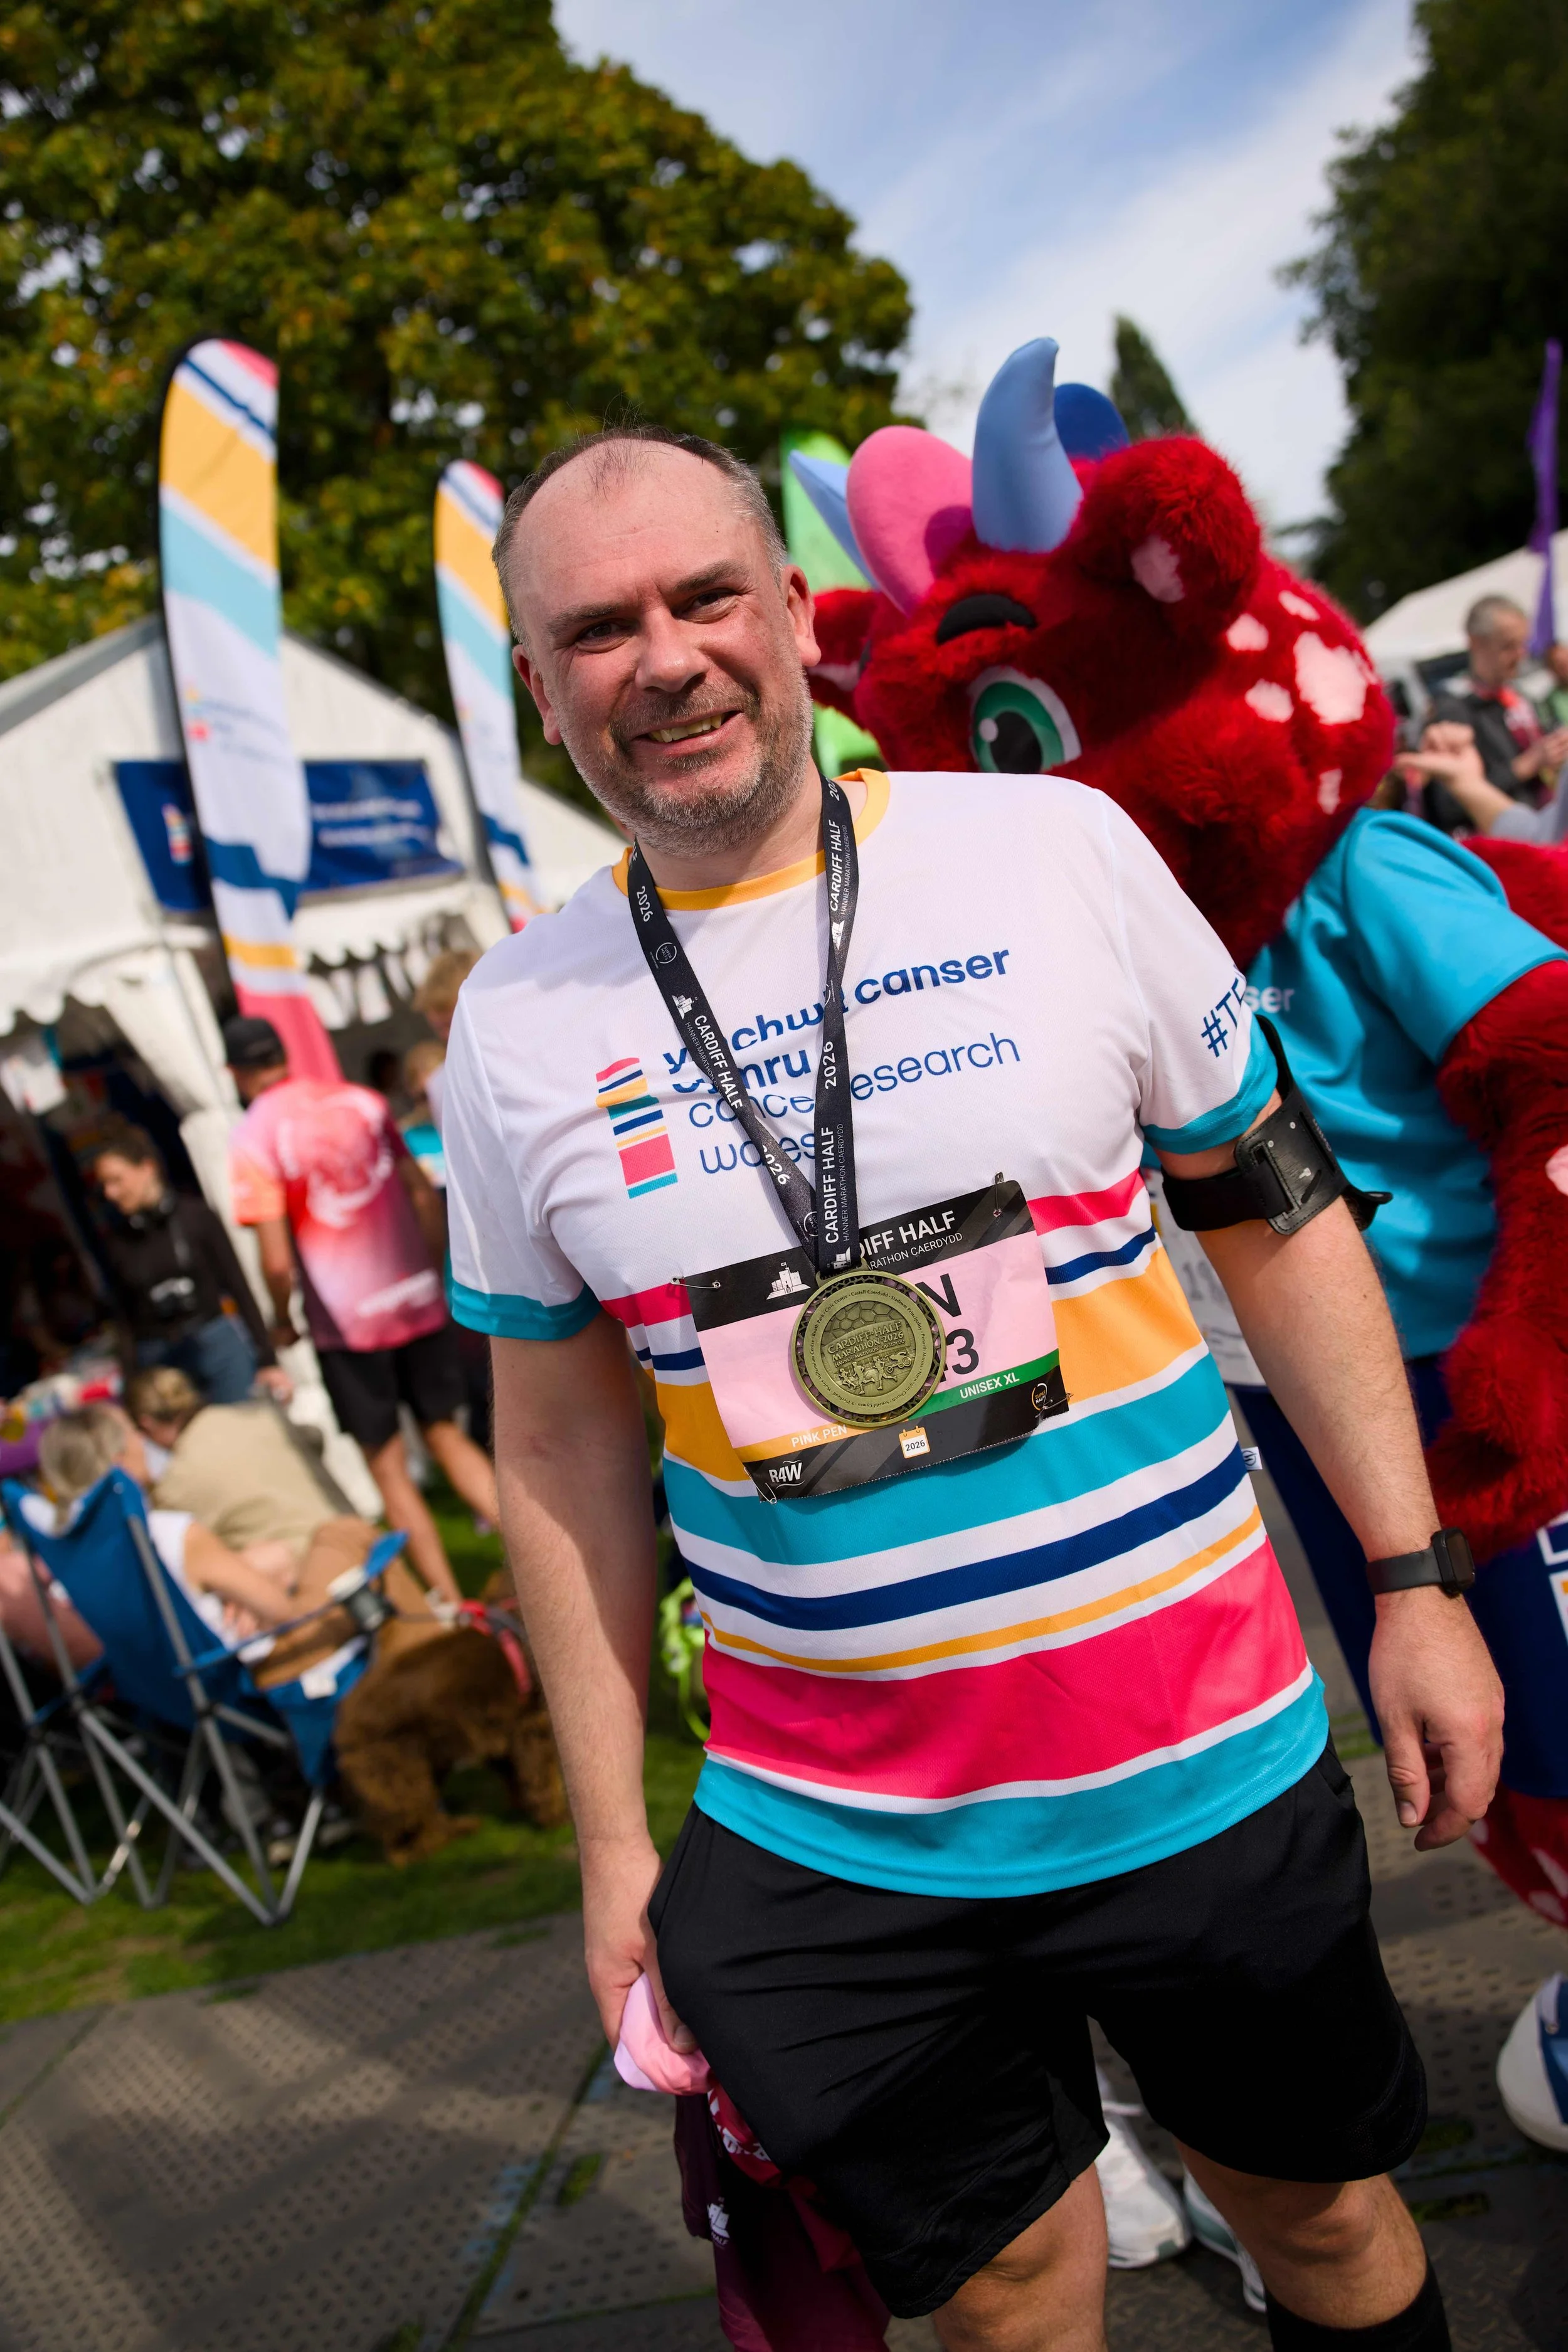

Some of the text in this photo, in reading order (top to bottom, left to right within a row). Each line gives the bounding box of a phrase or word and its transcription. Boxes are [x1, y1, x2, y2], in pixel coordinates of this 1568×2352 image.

[842, 825, 850, 852] CAERDYDD
[829, 819, 842, 911] CARDIFF HALF
[637, 886, 654, 922] 2026
[840, 887, 849, 915] HANNER
[855, 950, 1009, 1004] canser
[685, 1022, 715, 1079] HANNER MARATHON
[694, 1015, 743, 1110] CARDIFF HALF
[822, 1041, 837, 1089] 2026
[821, 1127, 839, 1244] CARDIFF HALF
[837, 1123, 849, 1241] HANNER MARATHON CAERDYDD
[899, 1210, 955, 1244] HALF
[911, 1232, 963, 1256] CAERDYDD
[824, 1303, 834, 1313] Civic
[834, 1295, 847, 1305] Centre
[890, 1295, 908, 1308] Stadiwm
[817, 1313, 825, 1323] Park
[906, 1306, 923, 1330] Principality
[828, 1322, 902, 1353] CARDIFF HALF
[832, 1331, 904, 1362] MARATHON 2026
[834, 1340, 905, 1367] HANNER MARATHON CAERDYDD
[960, 1372, 1020, 1399] UNISEX XL
[792, 1425, 847, 1448] PINK PEN
[905, 1439, 925, 1452] 2026
[769, 1462, 802, 1483] R4W
